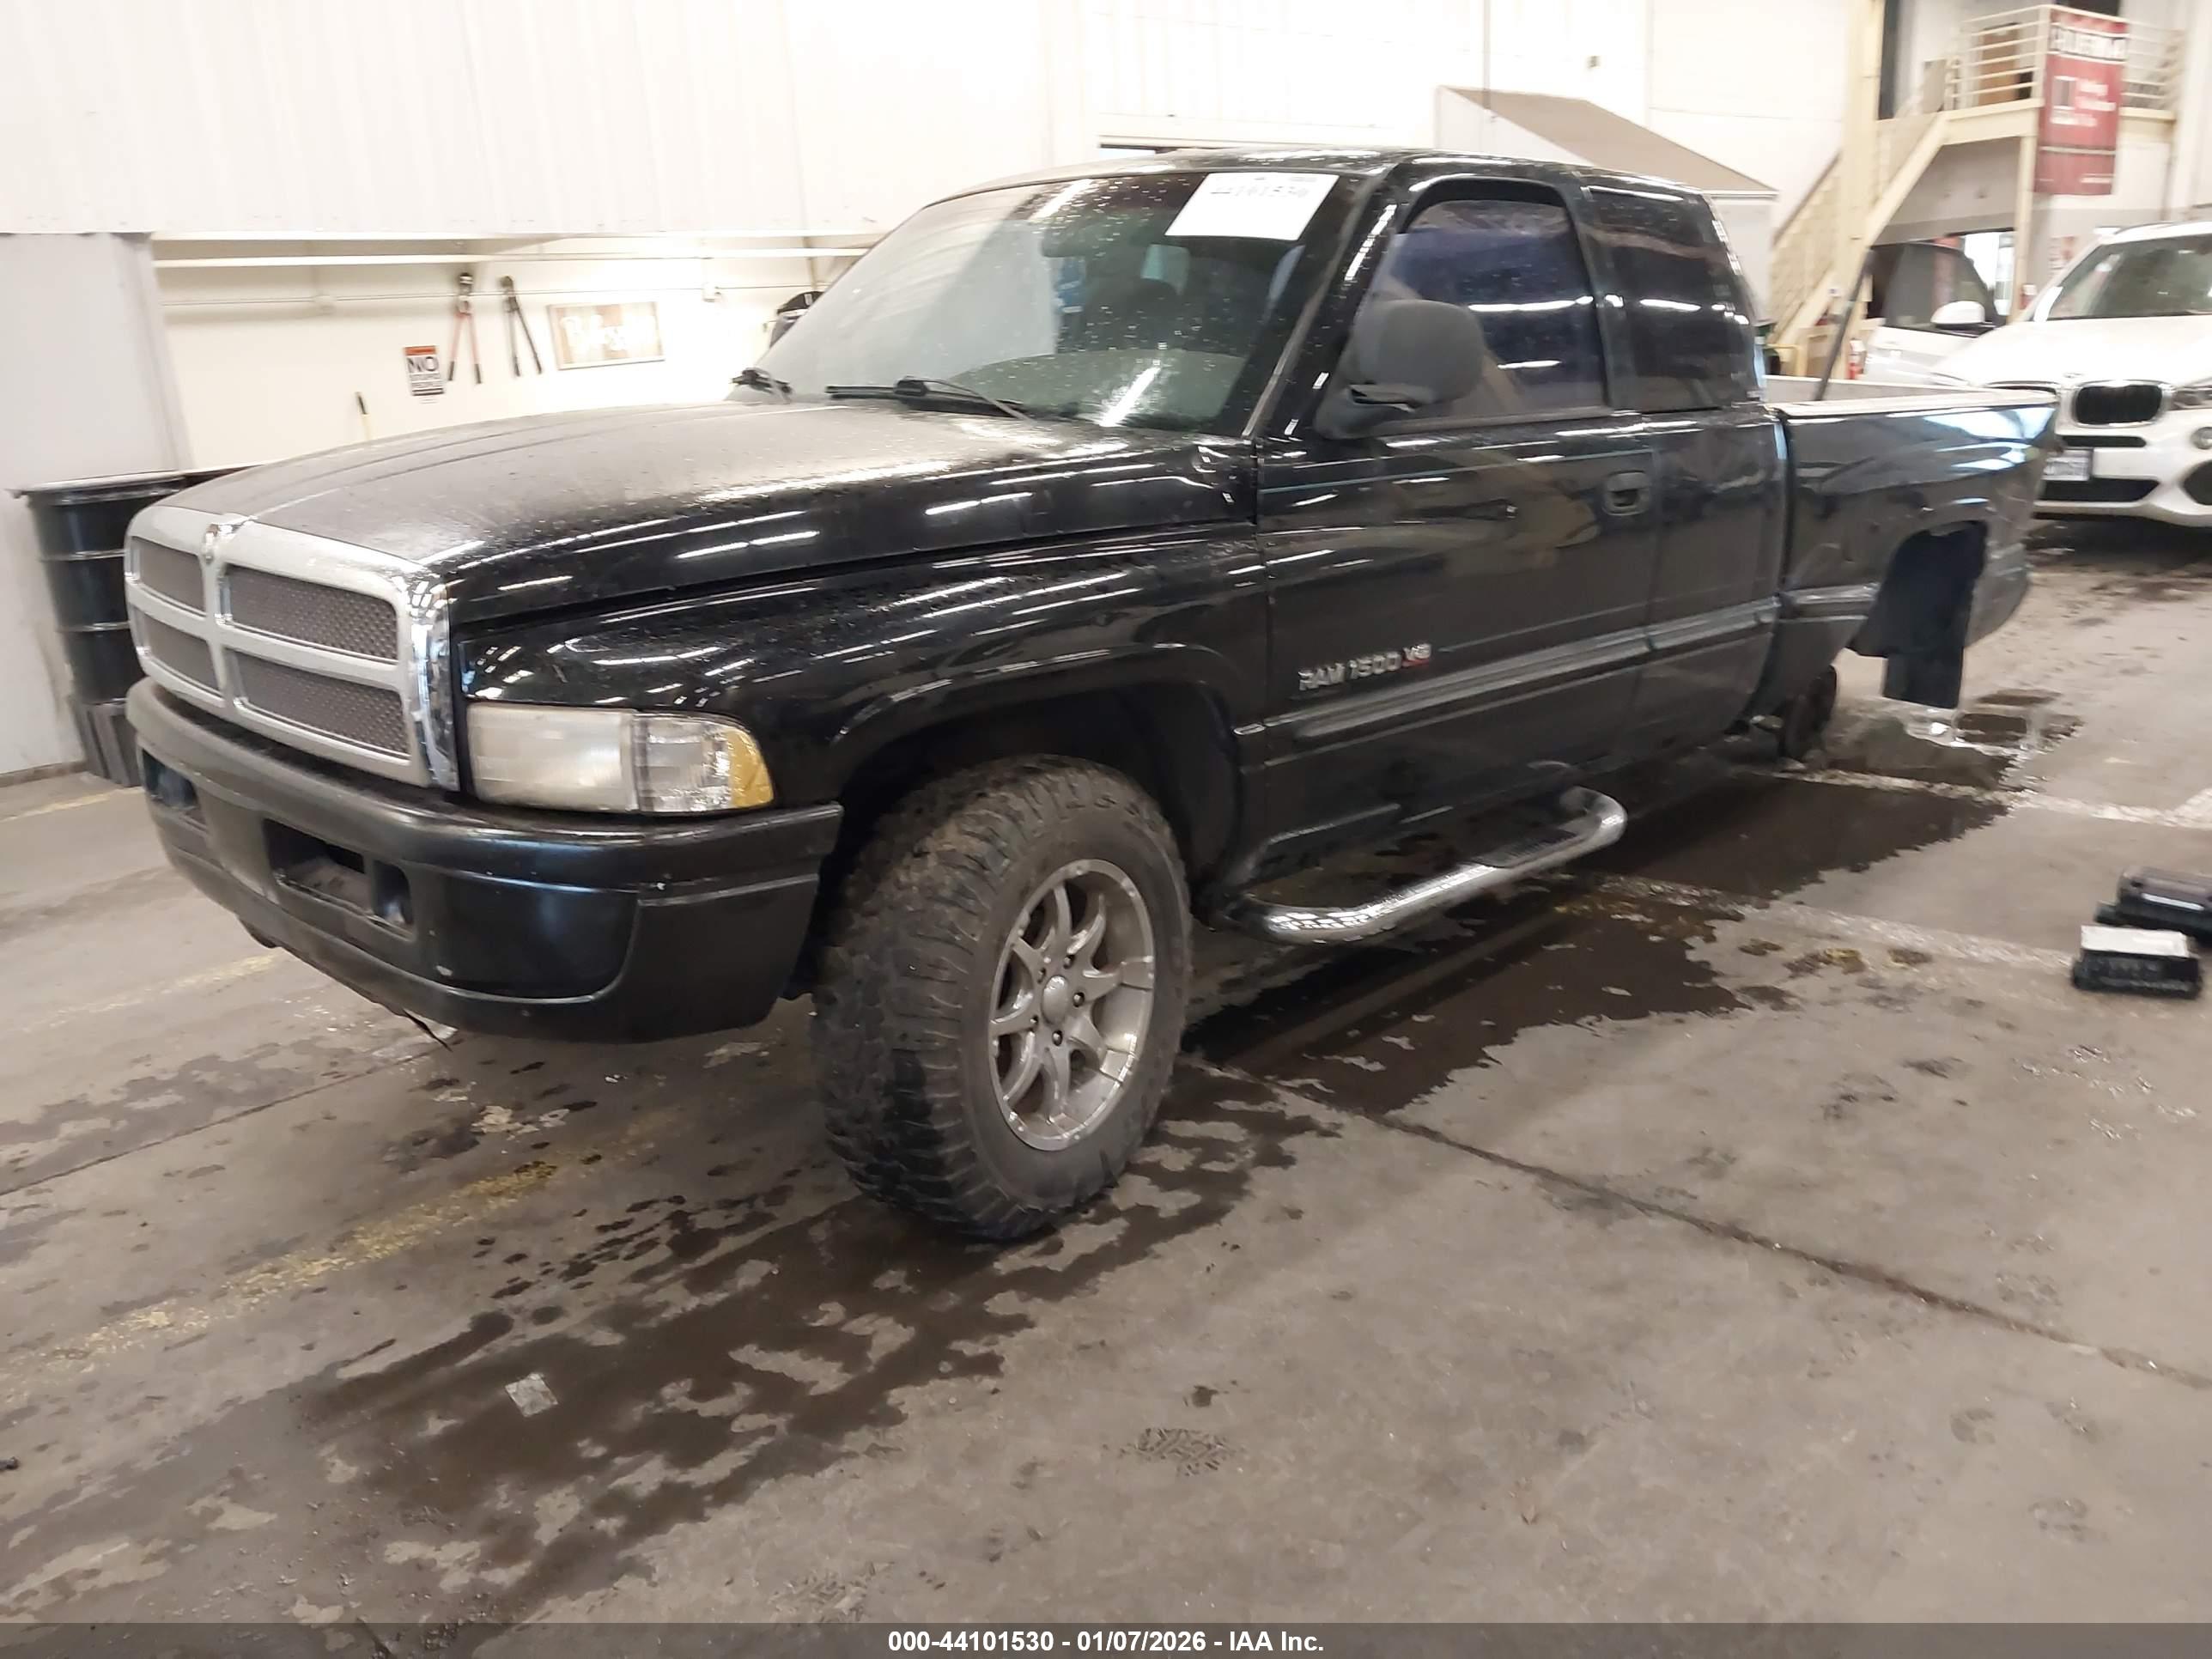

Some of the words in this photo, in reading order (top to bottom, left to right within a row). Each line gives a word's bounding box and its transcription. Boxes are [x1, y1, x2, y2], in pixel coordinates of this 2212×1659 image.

[407, 356, 440, 373] NO
[1297, 663, 1346, 690] RAM
[1348, 651, 1402, 679] 1500
[1402, 643, 1432, 661] V8
